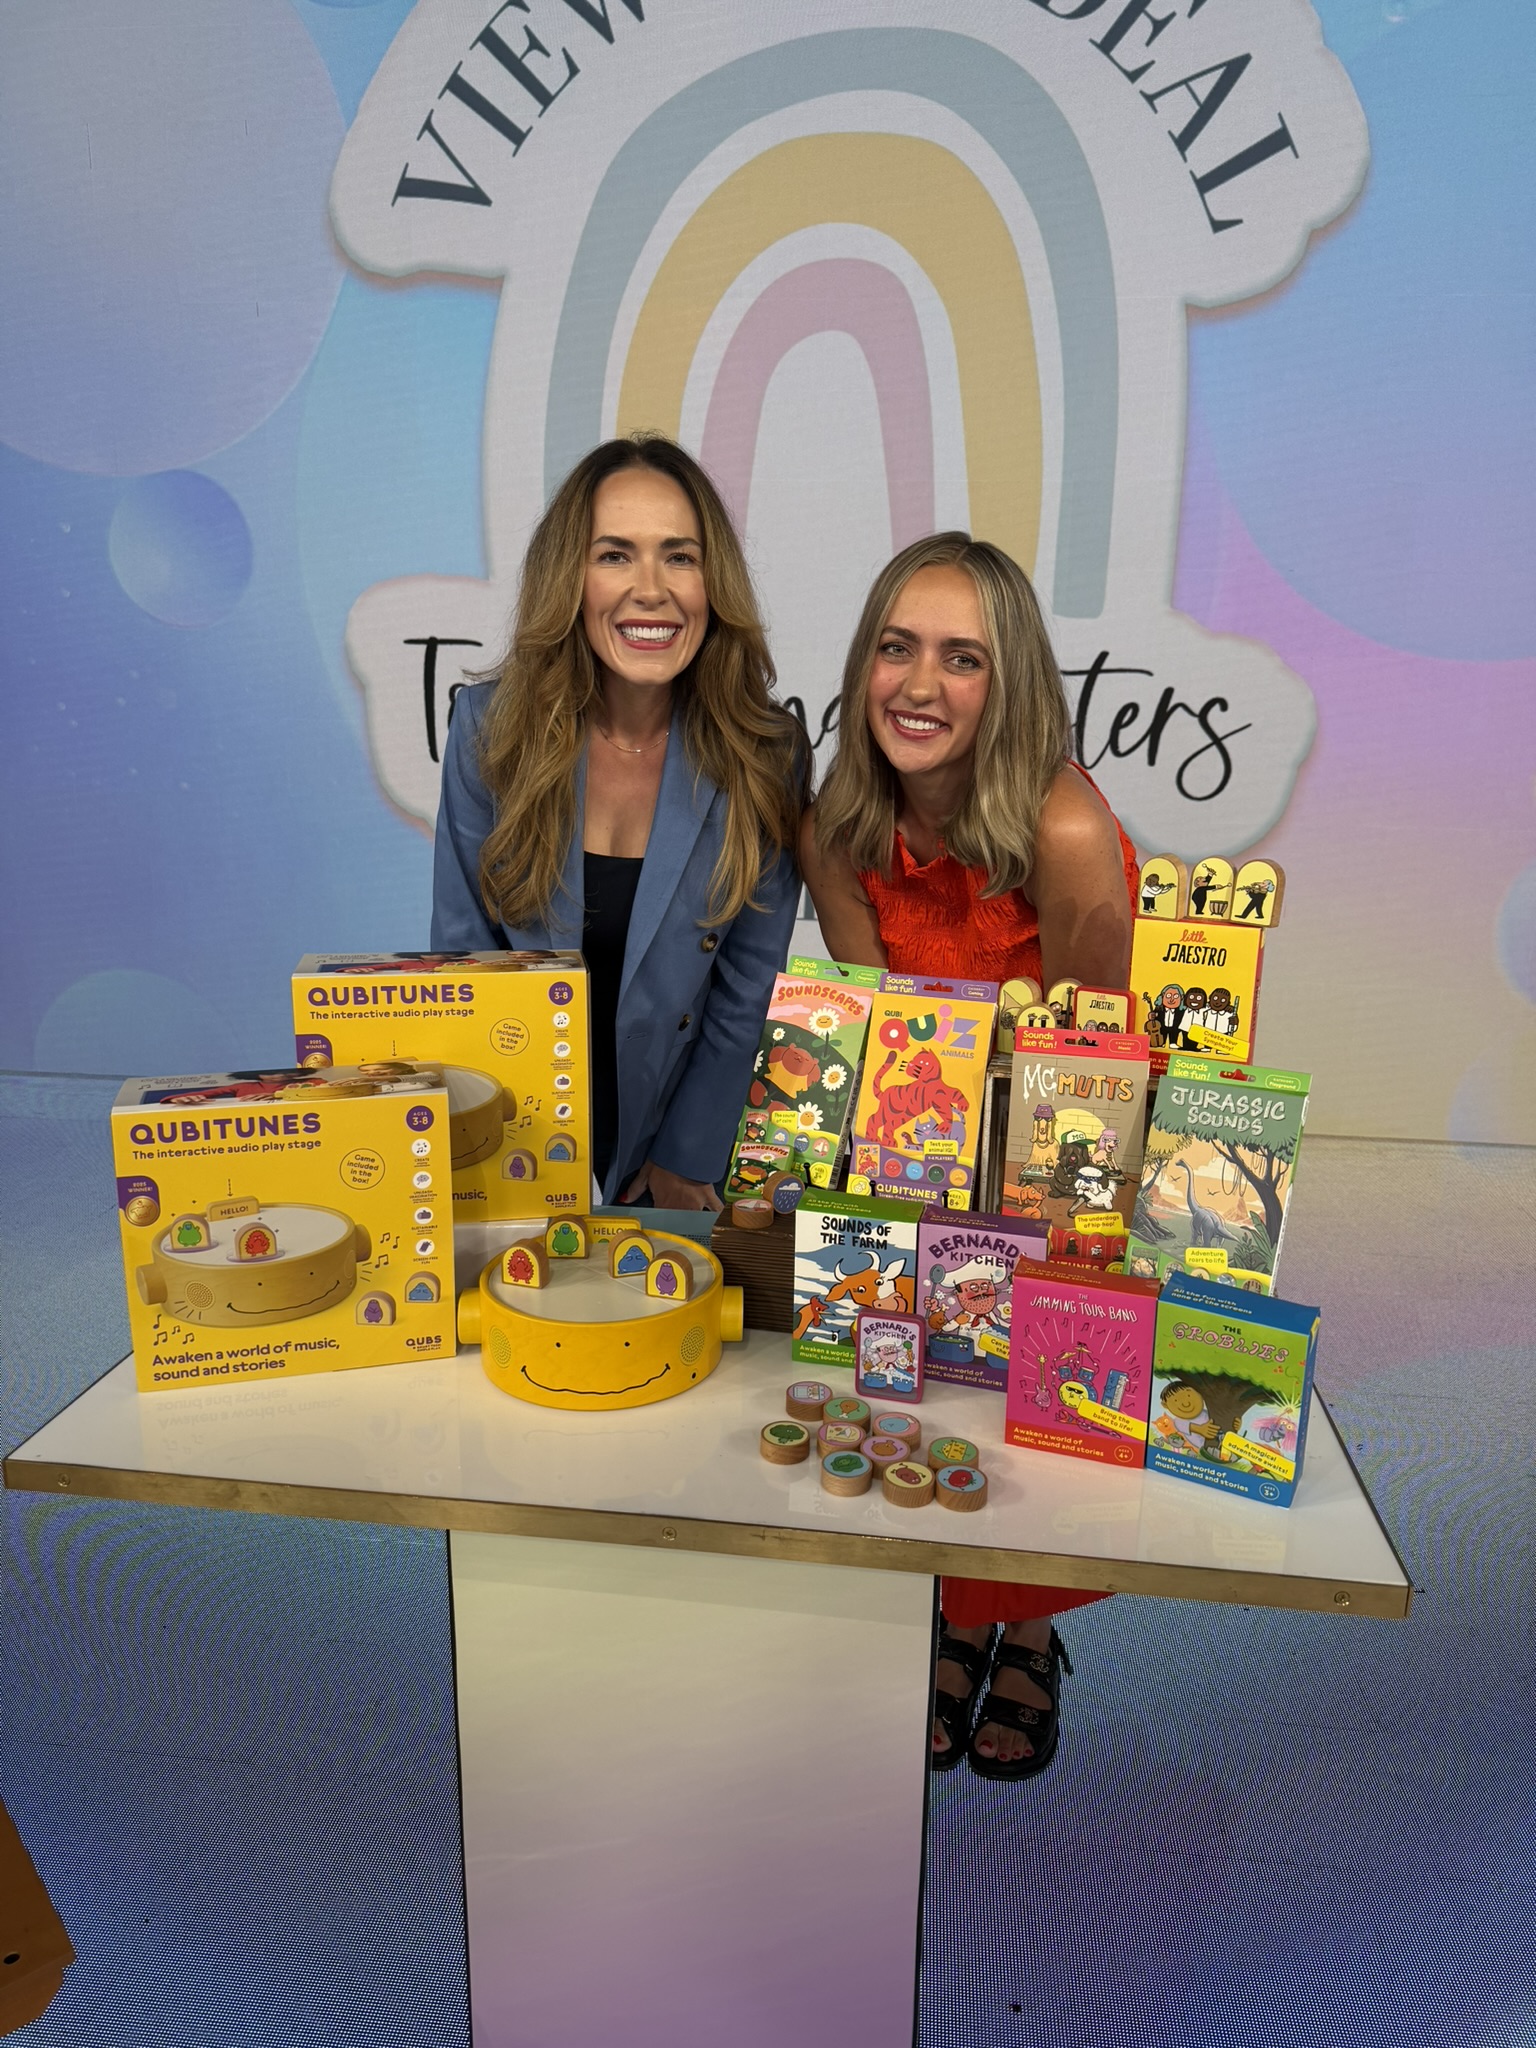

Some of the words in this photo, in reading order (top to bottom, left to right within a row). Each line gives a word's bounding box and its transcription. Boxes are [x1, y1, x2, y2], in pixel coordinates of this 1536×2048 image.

[1060, 651, 1252, 801] ters
[1179, 929, 1208, 943] little
[793, 959, 817, 969] Sounds
[804, 968, 818, 976] fun!
[886, 976, 914, 985] Sounds
[308, 984, 475, 1006] QUBITUNES
[884, 984, 898, 992] like
[899, 985, 916, 993] fun!
[554, 992, 568, 1000] 3-8
[777, 984, 864, 1016] SOUNDSCAPES
[310, 1012, 329, 1020] The
[331, 1010, 390, 1019] interactive
[392, 1009, 421, 1017] audio
[423, 1008, 443, 1018] play
[445, 1008, 475, 1017] stage
[496, 1029, 524, 1039] included
[503, 1023, 521, 1032] Game
[1023, 1030, 1054, 1040] Sounds
[1203, 1030, 1223, 1042] Create
[1224, 1037, 1239, 1047] Your
[501, 1043, 515, 1051] box!
[1021, 1039, 1037, 1047] like
[1038, 1040, 1057, 1049] fun!
[1203, 1037, 1235, 1052] Symphony!
[940, 1050, 975, 1059] ANIMALS
[1175, 1059, 1208, 1071] Sounds
[1173, 1068, 1189, 1077] like
[1190, 1071, 1211, 1081] fun!
[1057, 1073, 1133, 1102] MUTTS
[1171, 1086, 1286, 1121] JURASSIC
[412, 1117, 428, 1126] 3-8
[1187, 1107, 1264, 1136] SOUNDS
[130, 1112, 321, 1145] QUBITUNES
[132, 1150, 154, 1160] The
[157, 1146, 224, 1158] interactive
[227, 1143, 259, 1154] audio
[262, 1142, 285, 1153] play
[287, 1140, 321, 1150] stage
[741, 1145, 788, 1156] SOUNDSCAPES
[354, 1154, 376, 1163] Game
[347, 1160, 379, 1171] included
[359, 1169, 372, 1177] the
[352, 1176, 369, 1184] box!
[545, 1193, 577, 1202] QUBS
[876, 1183, 938, 1200] QUBITUNES
[220, 1205, 248, 1216] HELLO!
[821, 1216, 872, 1235] SOUNDS
[876, 1225, 892, 1237] OF
[820, 1232, 845, 1245] THE
[852, 1236, 887, 1250] FARM
[950, 1251, 1015, 1269] KITCHEN
[1171, 1292, 1191, 1300] none
[1220, 1304, 1252, 1315] screens
[1218, 1298, 1237, 1306] with
[1030, 1295, 1076, 1314] JAMMING
[1079, 1302, 1106, 1318] TOUR
[1108, 1306, 1137, 1323] BAND
[863, 1321, 917, 1341] BERNARD'S
[874, 1330, 907, 1340] KITCHEN
[1222, 1324, 1242, 1335] THE
[405, 1335, 442, 1347] QUBS
[990, 1338, 1002, 1348] Can
[1172, 1322, 1289, 1363] GROBLIES
[152, 1352, 213, 1366] Awaken
[215, 1352, 224, 1360] a
[226, 1344, 270, 1359] world
[272, 1341, 293, 1354] of
[294, 1337, 340, 1352] music,
[799, 1345, 825, 1354] Awaken
[799, 1352, 819, 1360] music,
[996, 1347, 1007, 1355] the
[153, 1367, 200, 1382] sound
[202, 1364, 229, 1377] and
[232, 1358, 286, 1373] stories
[954, 1367, 973, 1375] world
[943, 1372, 963, 1380] sound
[978, 1378, 1003, 1387] stories
[1092, 1413, 1110, 1423] band
[1110, 1419, 1119, 1427] to
[1119, 1423, 1134, 1433] life!
[1100, 1408, 1118, 1420] Bring
[1118, 1415, 1131, 1425] the
[1013, 1427, 1043, 1438] Awaken
[1049, 1435, 1072, 1445] world
[1013, 1435, 1036, 1445] music,
[1037, 1439, 1060, 1449] sound
[1061, 1444, 1075, 1452] and
[1076, 1446, 1104, 1457] stories
[1228, 1442, 1262, 1462] adventure
[1263, 1460, 1289, 1475] awaits!
[1250, 1446, 1277, 1462] magical
[1155, 1453, 1186, 1468] Awaken
[1192, 1464, 1216, 1476] world
[1155, 1460, 1179, 1473] music,
[1180, 1467, 1204, 1479] sound
[1204, 1474, 1219, 1484] and
[1220, 1479, 1249, 1492] stories
